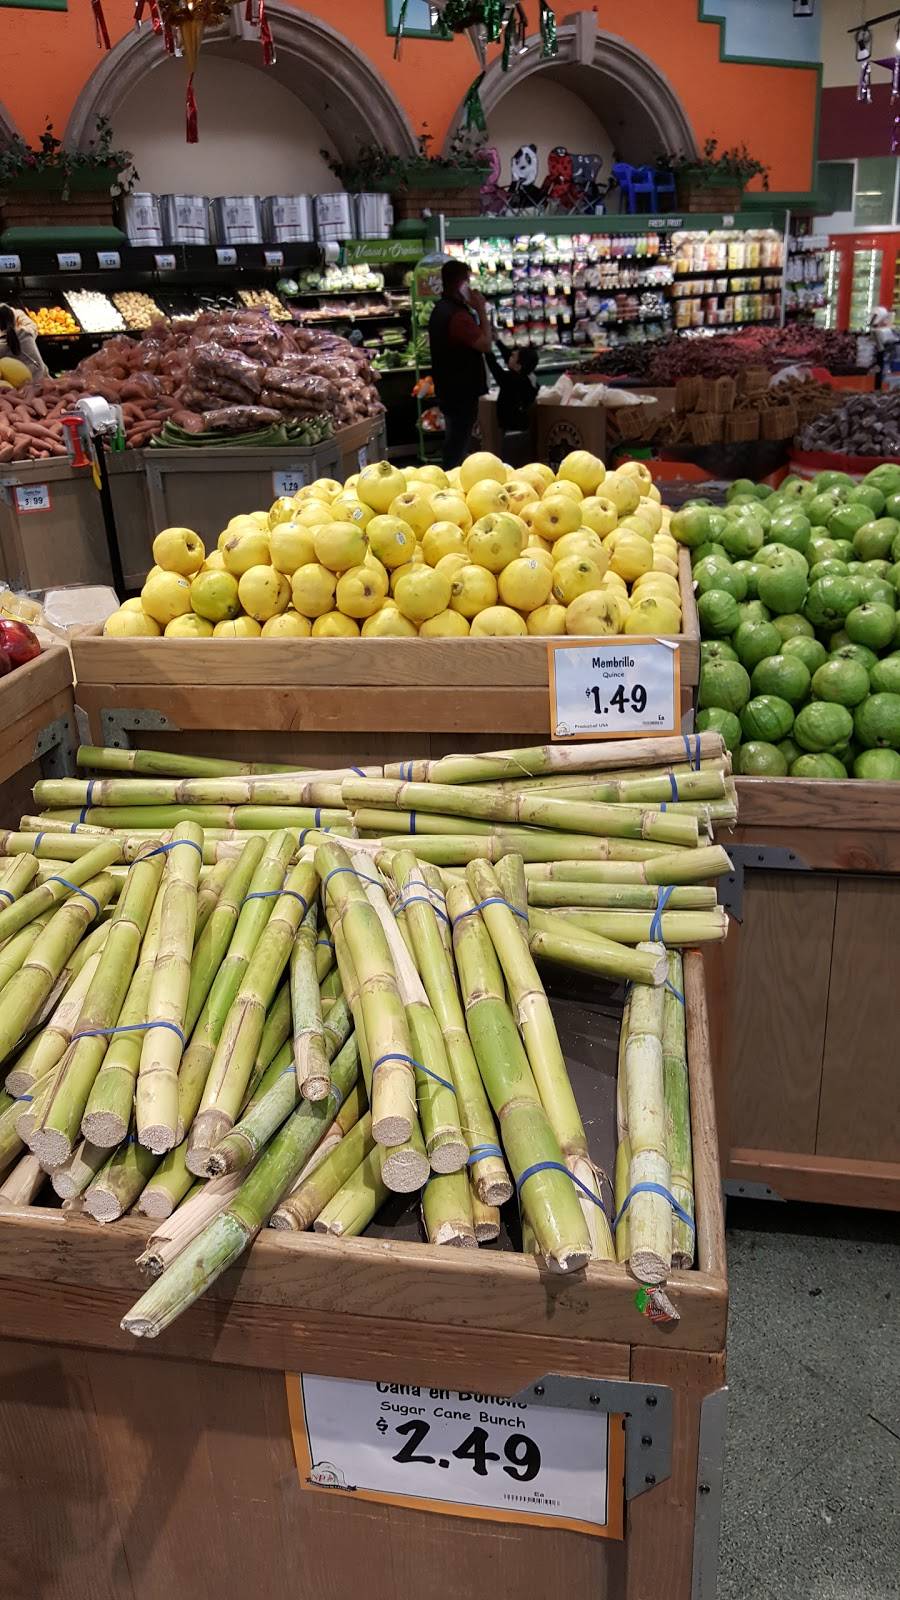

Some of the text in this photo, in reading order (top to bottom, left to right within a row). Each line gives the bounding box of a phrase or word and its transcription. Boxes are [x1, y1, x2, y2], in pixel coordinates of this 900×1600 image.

[592, 656, 635, 669] Membrillo
[429, 1388, 450, 1400] en
[380, 1401, 526, 1429] Sugar Cane Bunch
